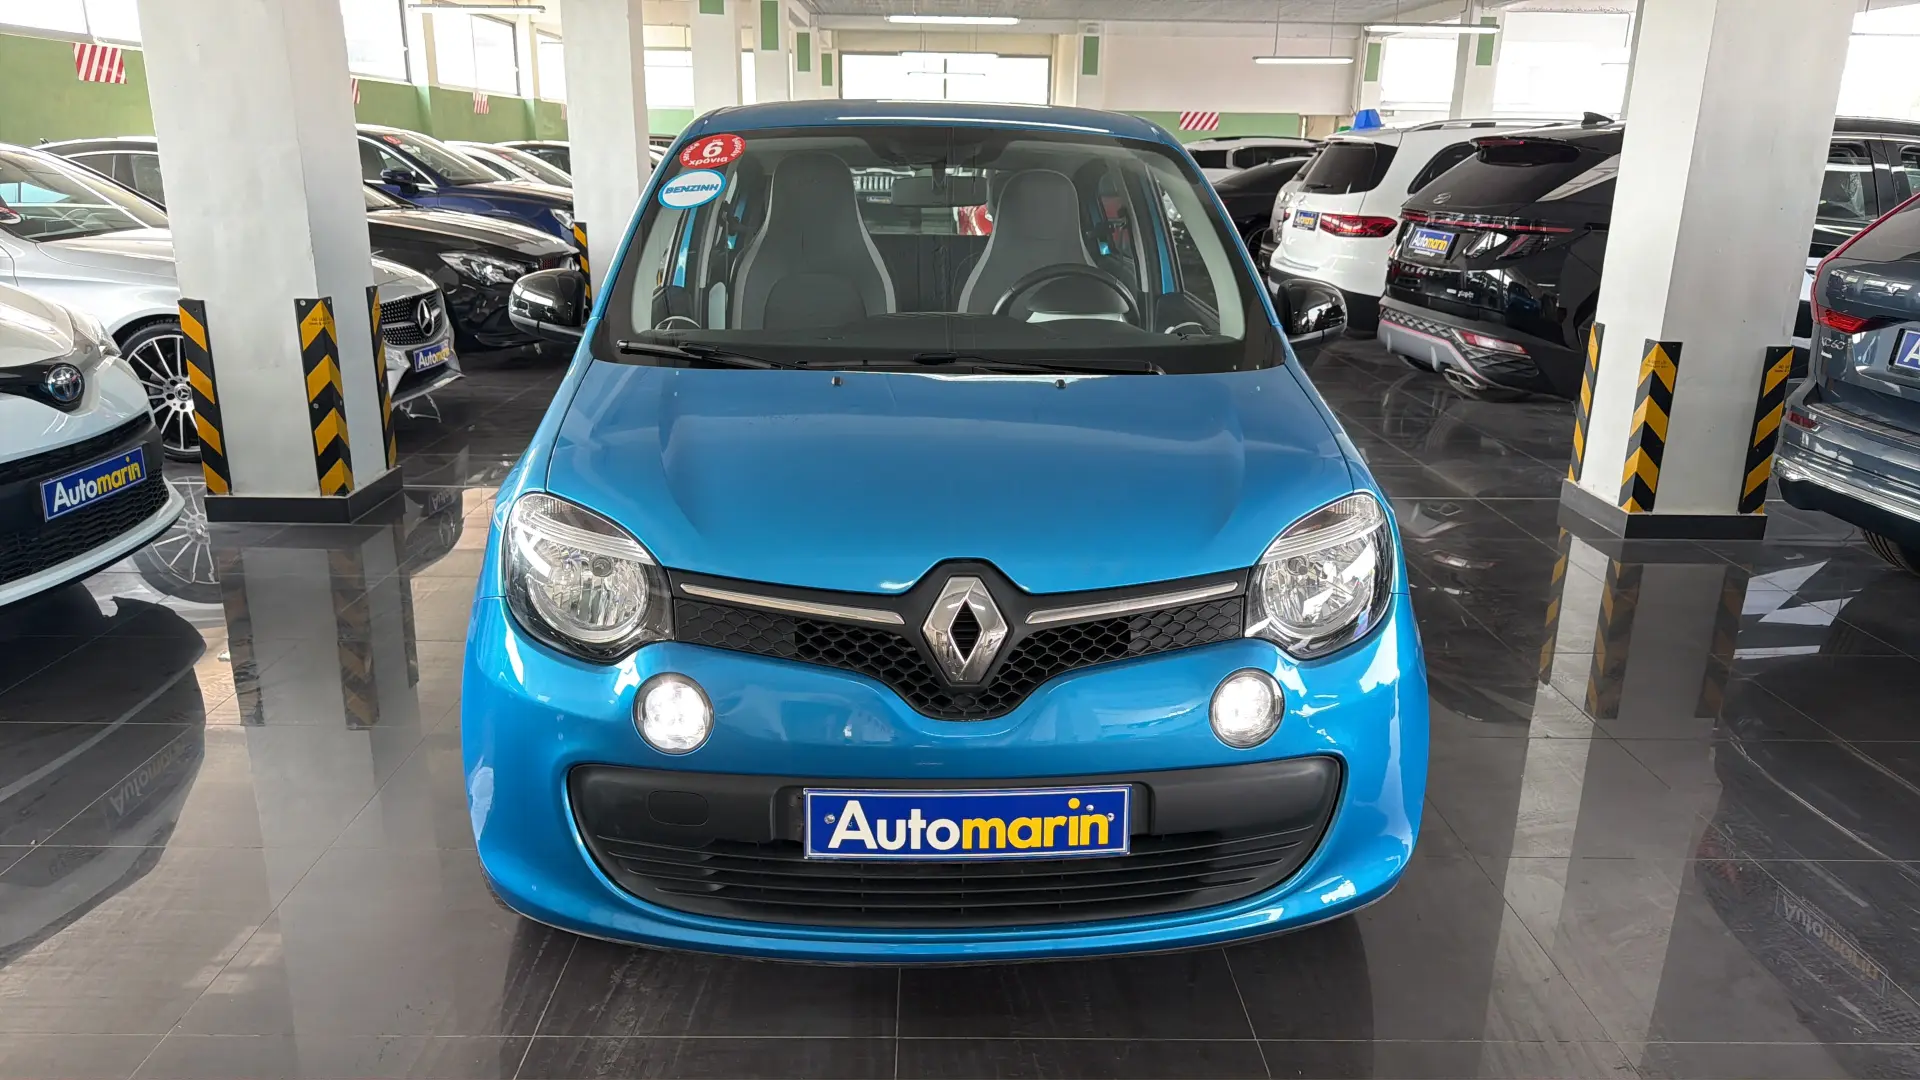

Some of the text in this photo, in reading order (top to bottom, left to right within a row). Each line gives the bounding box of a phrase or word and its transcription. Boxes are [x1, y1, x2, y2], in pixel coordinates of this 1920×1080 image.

[702, 141, 724, 158] 6
[688, 156, 728, 167] χρόνια
[1411, 231, 1449, 251] Automarin
[53, 456, 141, 513] Automarin
[828, 797, 1109, 851] Automarin
